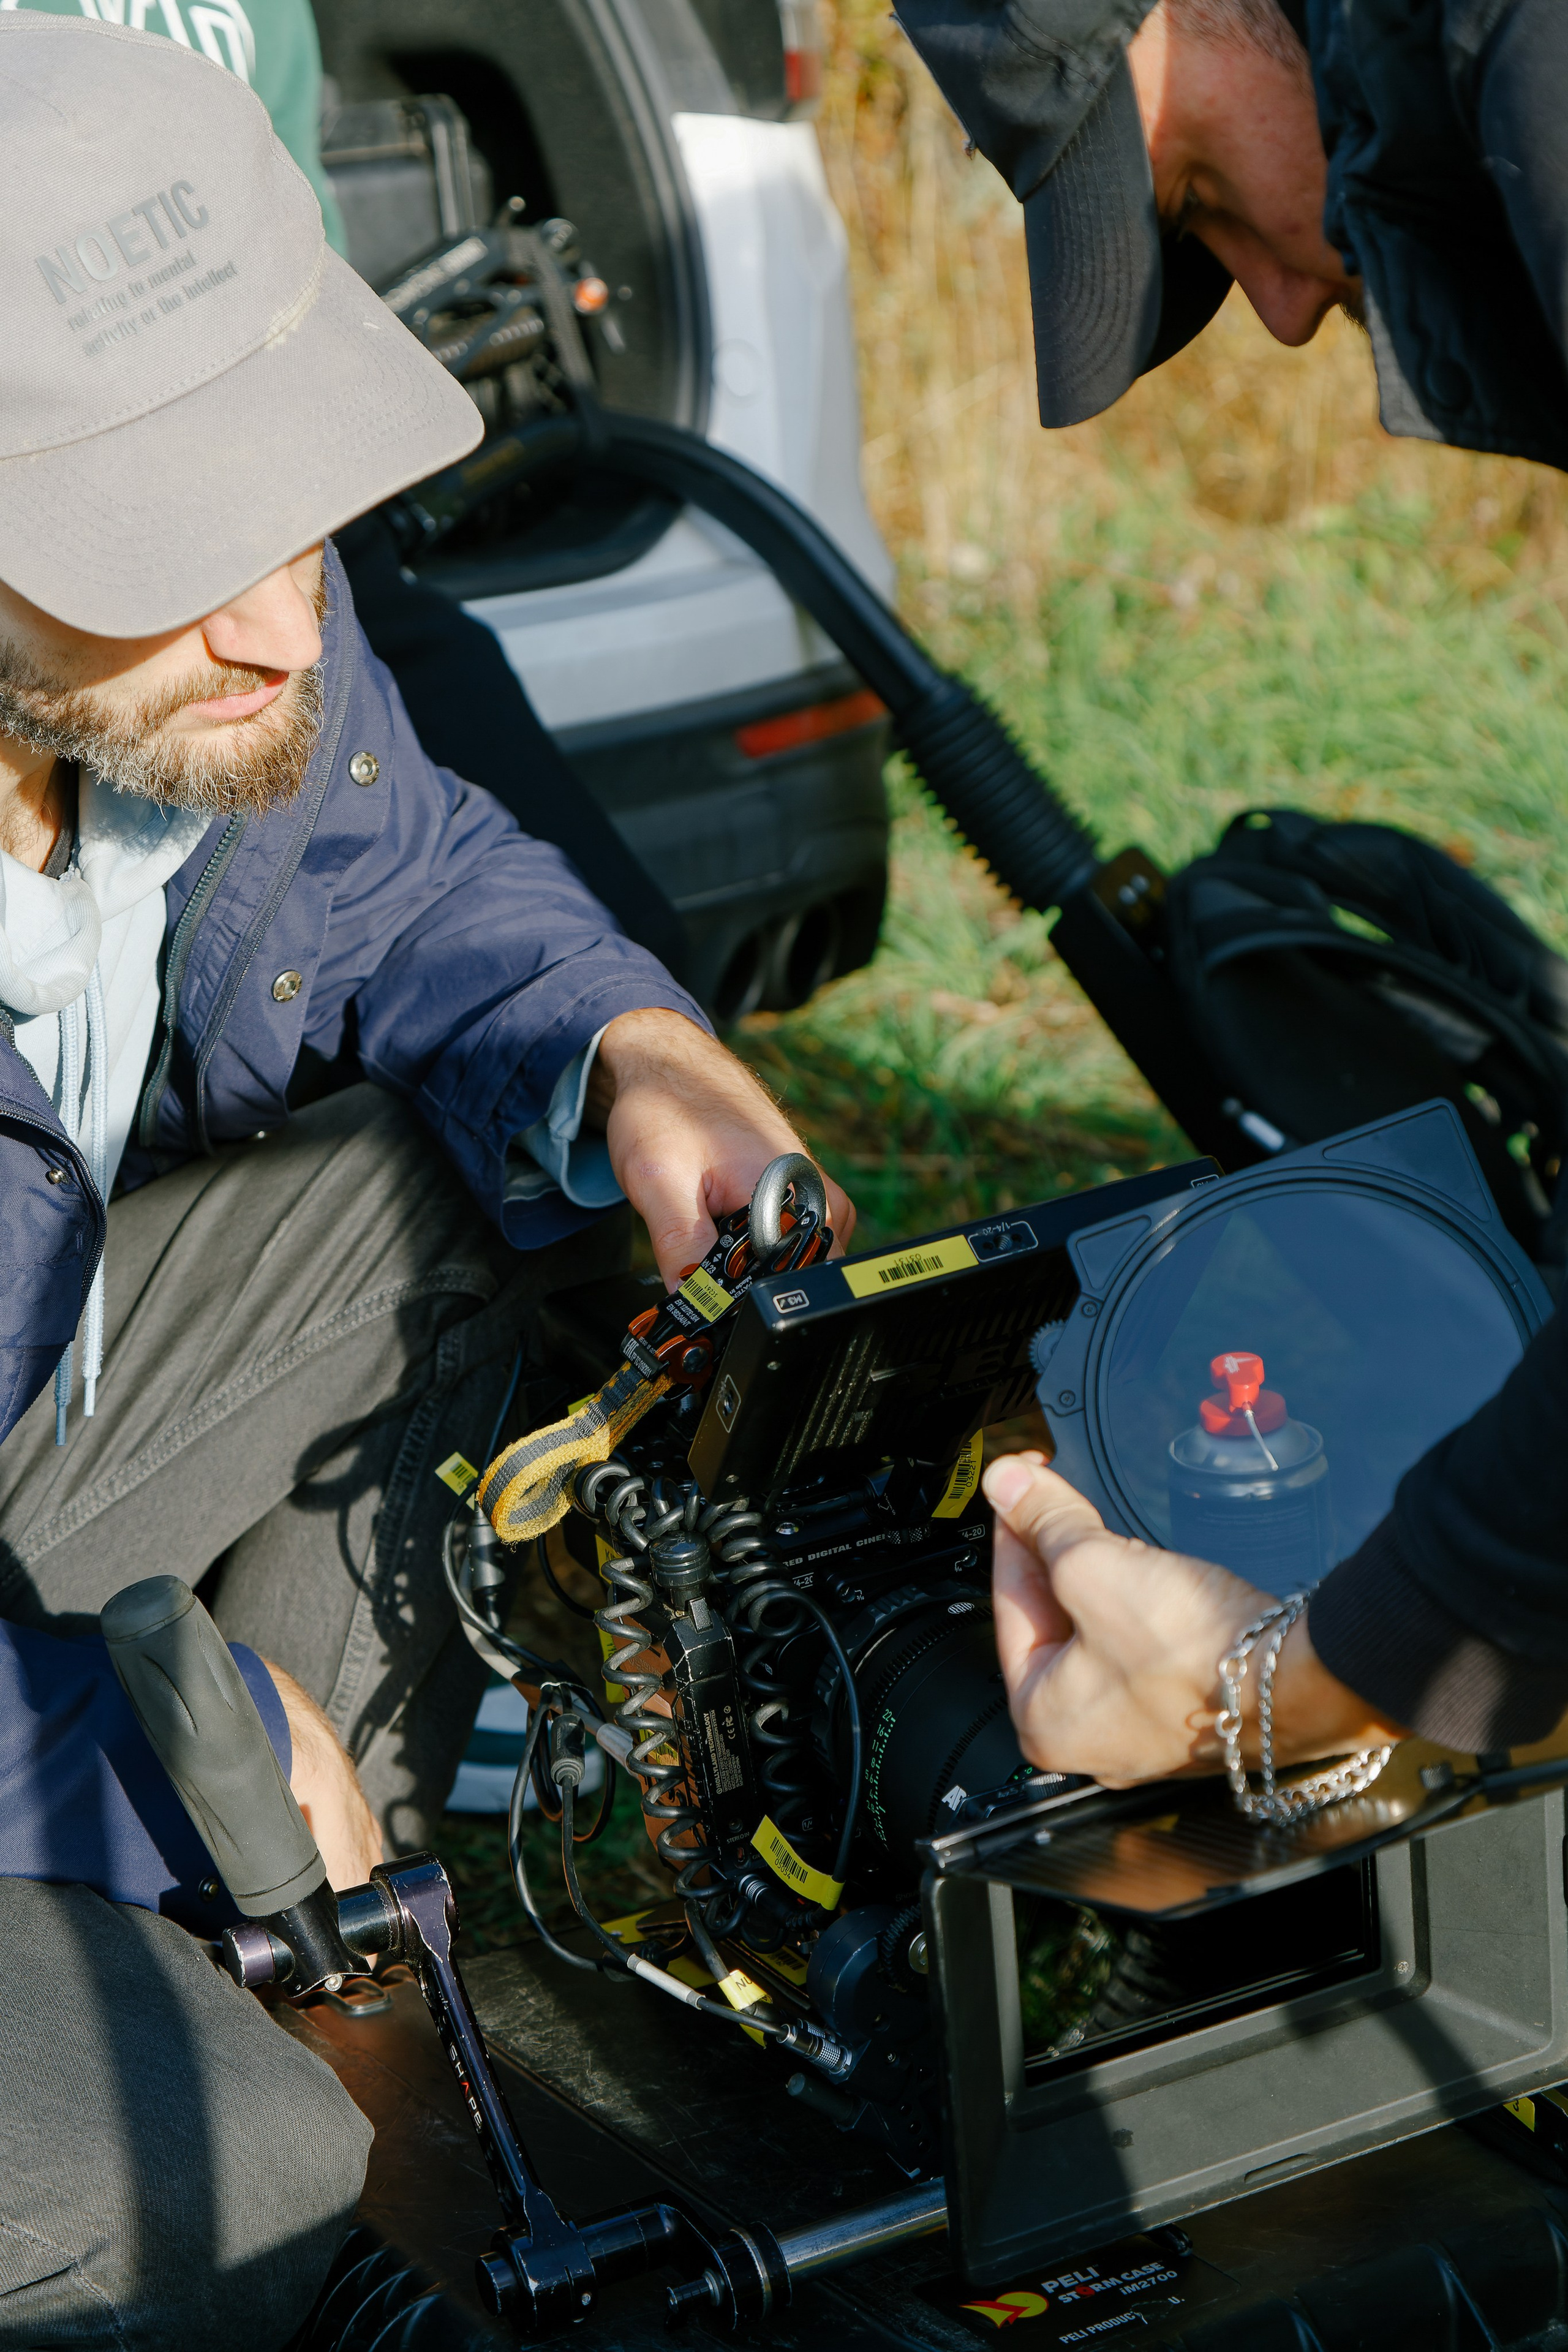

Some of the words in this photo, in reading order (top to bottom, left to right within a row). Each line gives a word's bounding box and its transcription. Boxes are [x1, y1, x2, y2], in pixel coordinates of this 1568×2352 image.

[36, 179, 209, 305] NOETIC
[68, 292, 128, 331] relating
[129, 282, 146, 297] to
[148, 249, 197, 289] mental
[83, 319, 139, 355] activity
[141, 306, 157, 325] of
[158, 295, 183, 314] the
[183, 259, 238, 300] intellect
[707, 1265, 717, 1275] 23
[894, 1253, 922, 1266] 03131
[735, 1275, 752, 1290] Made
[666, 1303, 674, 1313] EN
[674, 1298, 682, 1307] EN
[788, 1295, 803, 1305] M3
[966, 1460, 976, 1488] 03221
[808, 1544, 852, 1561] DIGITAL
[856, 1533, 886, 1547] CINE
[882, 1708, 892, 1722] 22
[703, 1713, 715, 1753] TECHNOLOGY
[877, 1724, 885, 1737] 16
[872, 1739, 879, 1752] 11
[710, 1753, 722, 1789] HOLLYLAND
[871, 1757, 876, 1768] 8
[774, 1858, 792, 1880] 05054
[450, 2044, 483, 2127] SHAPE
[1041, 2266, 1100, 2294] PELI
[1058, 2277, 1123, 2303] STORM
[1120, 2261, 1165, 2282] CASE
[1119, 2270, 1178, 2295] iM2700
[1058, 2329, 1089, 2344] PELI
[1086, 2310, 1136, 2334] PRODUC
